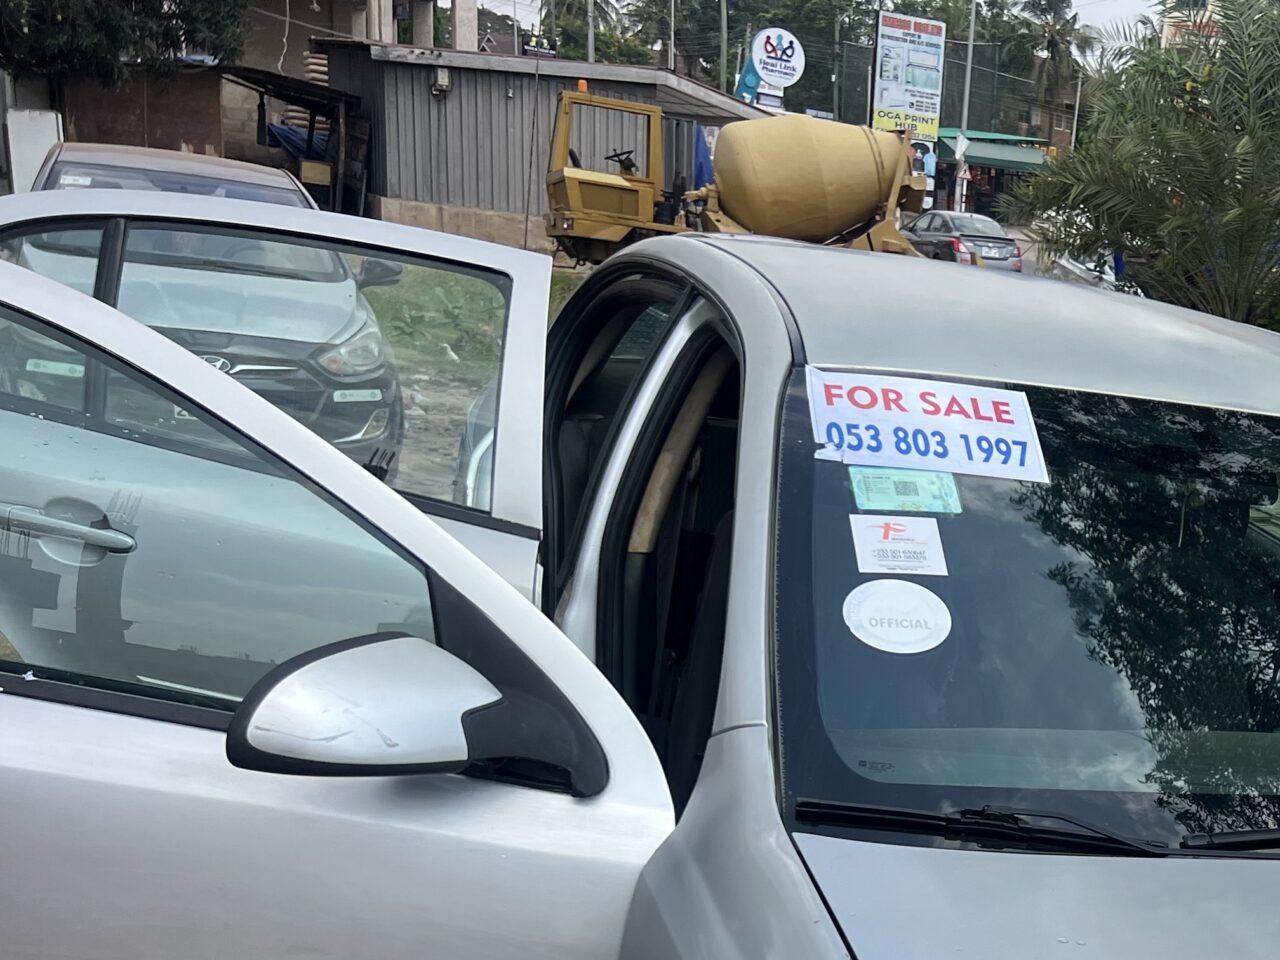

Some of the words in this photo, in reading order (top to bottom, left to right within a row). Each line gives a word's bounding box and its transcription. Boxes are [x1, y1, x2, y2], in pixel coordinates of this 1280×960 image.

[759, 59, 778, 68] Heal
[779, 62, 797, 72] Link
[762, 66, 795, 77] Pharmacy
[878, 110, 901, 120] OGA
[904, 114, 935, 125] PRINT
[895, 121, 917, 131] HUB
[823, 383, 908, 413] FOR
[918, 391, 1015, 425] SALE
[826, 421, 883, 453] 053
[893, 426, 949, 459] 803
[960, 433, 1028, 467] 1997
[868, 617, 932, 630] OFFICIAL
